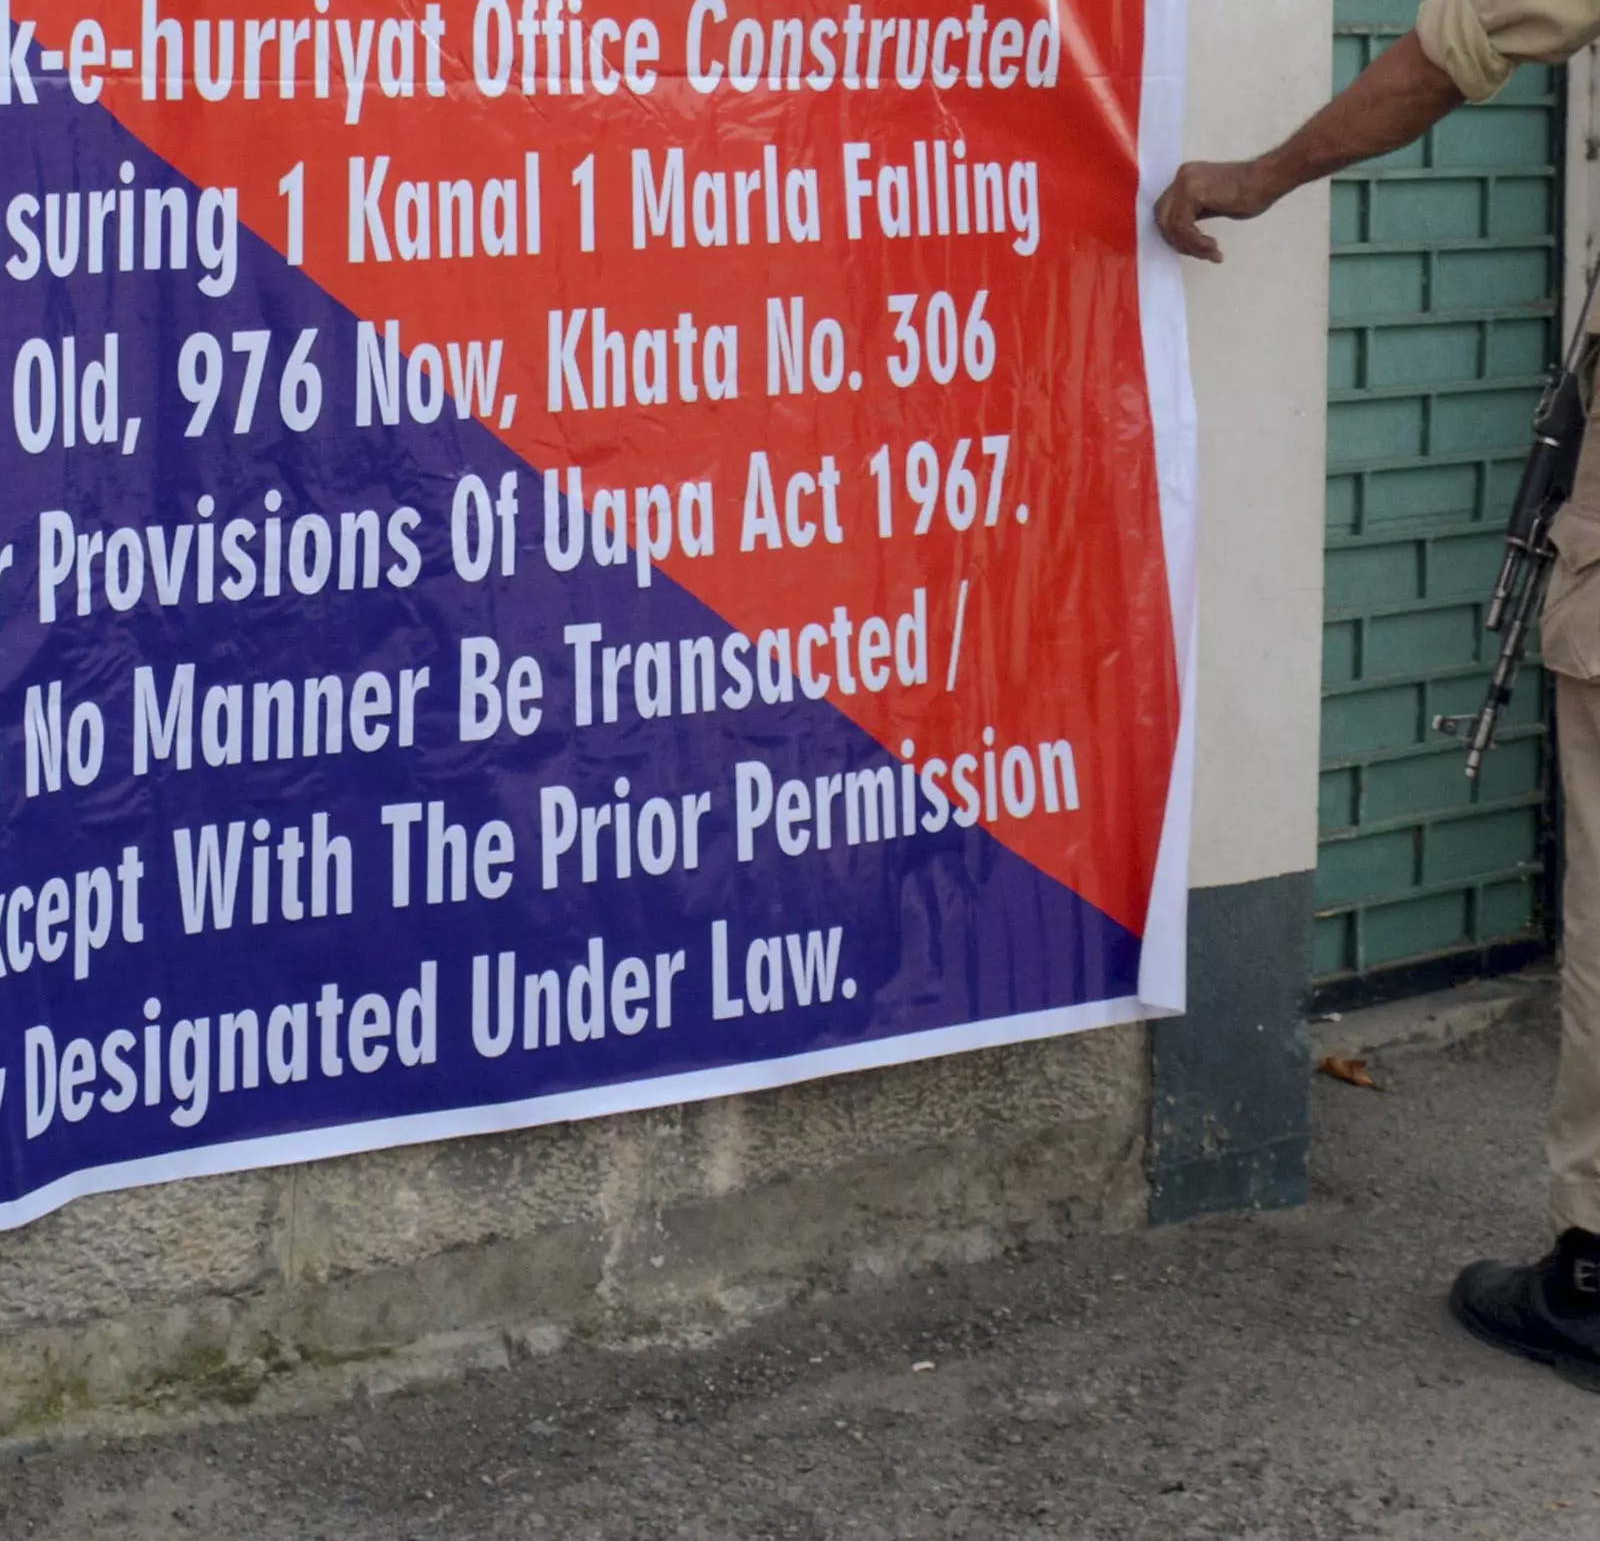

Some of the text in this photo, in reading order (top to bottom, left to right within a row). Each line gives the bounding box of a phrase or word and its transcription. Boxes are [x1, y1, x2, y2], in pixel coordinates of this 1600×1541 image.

[278, 161, 305, 266] 1
[348, 151, 541, 263] Kanal
[571, 153, 595, 252] 1
[631, 144, 821, 250] Marla
[842, 138, 1040, 256] Falling
[12, 332, 142, 455] Old,
[177, 327, 323, 437] 976
[355, 319, 518, 430] Now,
[547, 307, 739, 412] Khata
[766, 296, 863, 396] No.
[886, 289, 996, 388] 306
[38, 488, 422, 624] Provisions
[450, 470, 519, 583] Of
[543, 465, 715, 588] Uapa
[739, 450, 844, 552] Act
[869, 434, 1029, 538] 1967.
[24, 680, 105, 798] No
[133, 663, 430, 776] Manner
[459, 636, 543, 742] Be
[563, 587, 928, 727] Transacted
[946, 579, 969, 691] /
[173, 811, 352, 935] With
[381, 800, 515, 908] The
[540, 776, 711, 890] Prior
[735, 726, 1080, 862] Permission
[25, 960, 437, 1139] Designated
[472, 937, 685, 1058] Under
[712, 919, 857, 1020] Law.
